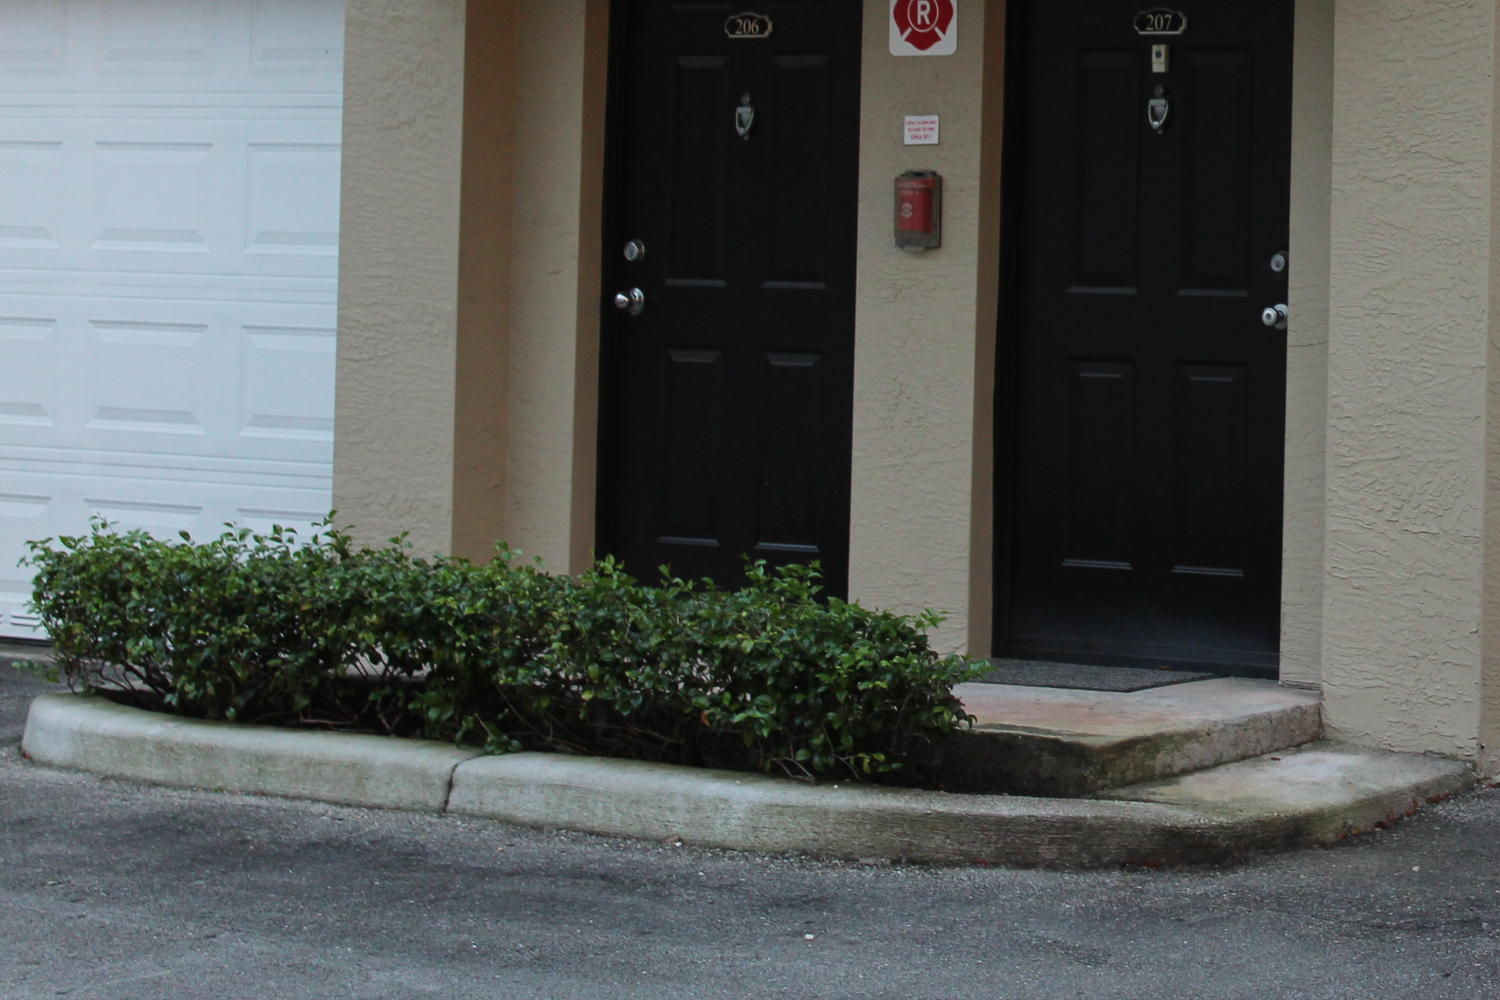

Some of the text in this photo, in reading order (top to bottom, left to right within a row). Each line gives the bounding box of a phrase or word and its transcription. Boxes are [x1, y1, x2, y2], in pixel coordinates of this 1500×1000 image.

[917, 0, 931, 25] R
[736, 19, 758, 35] 206
[1146, 14, 1172, 32] 207
